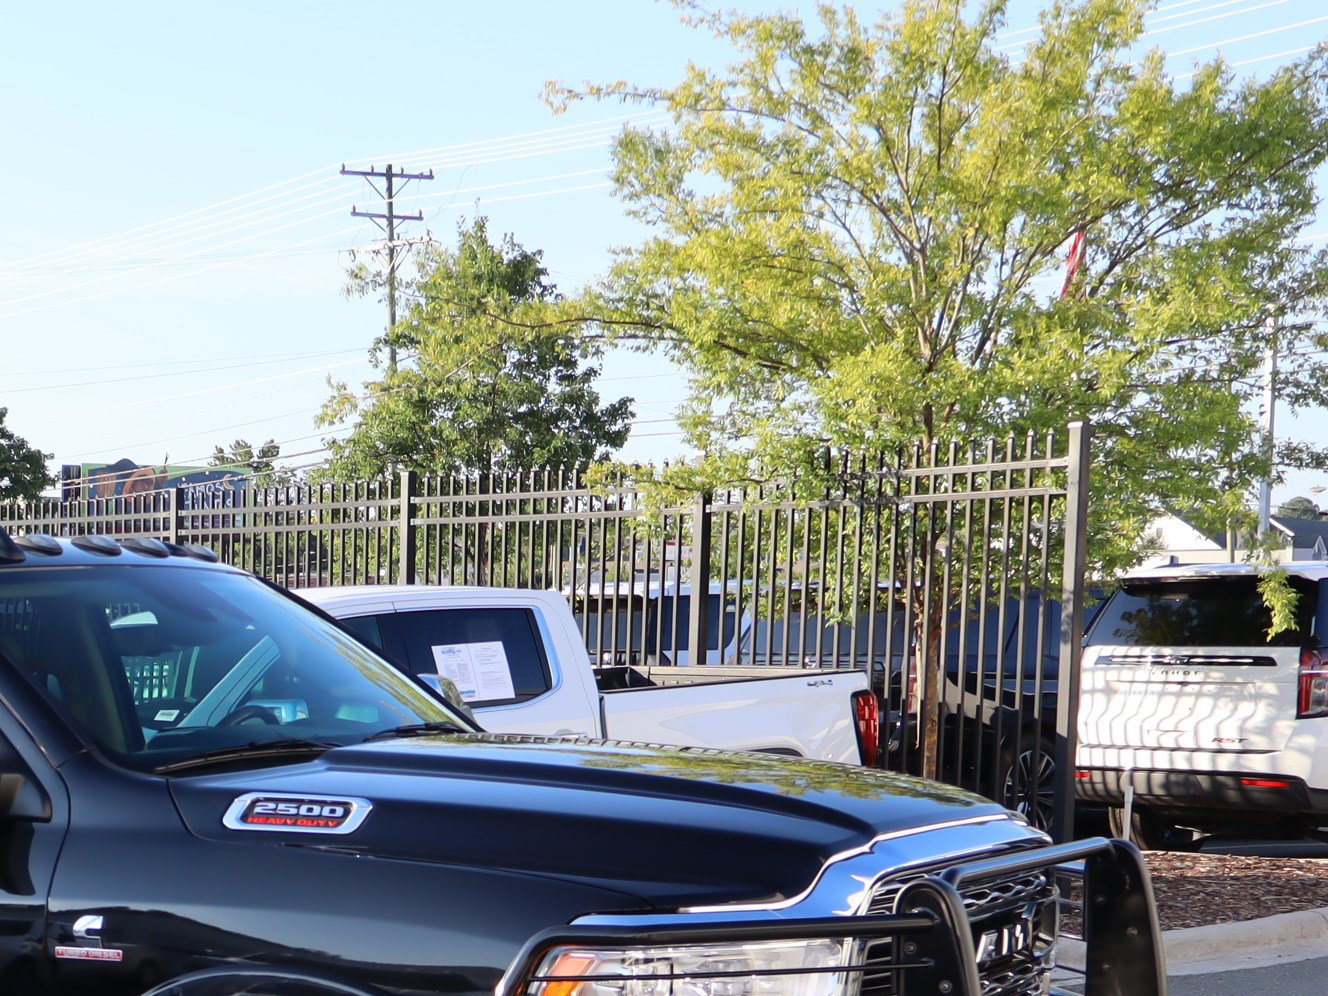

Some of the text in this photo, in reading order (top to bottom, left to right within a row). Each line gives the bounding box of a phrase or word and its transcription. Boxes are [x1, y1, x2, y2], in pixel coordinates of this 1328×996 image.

[253, 802, 345, 818] 2500
[247, 816, 340, 827] HEAVY DUTY
[88, 950, 121, 959] DIESEL
